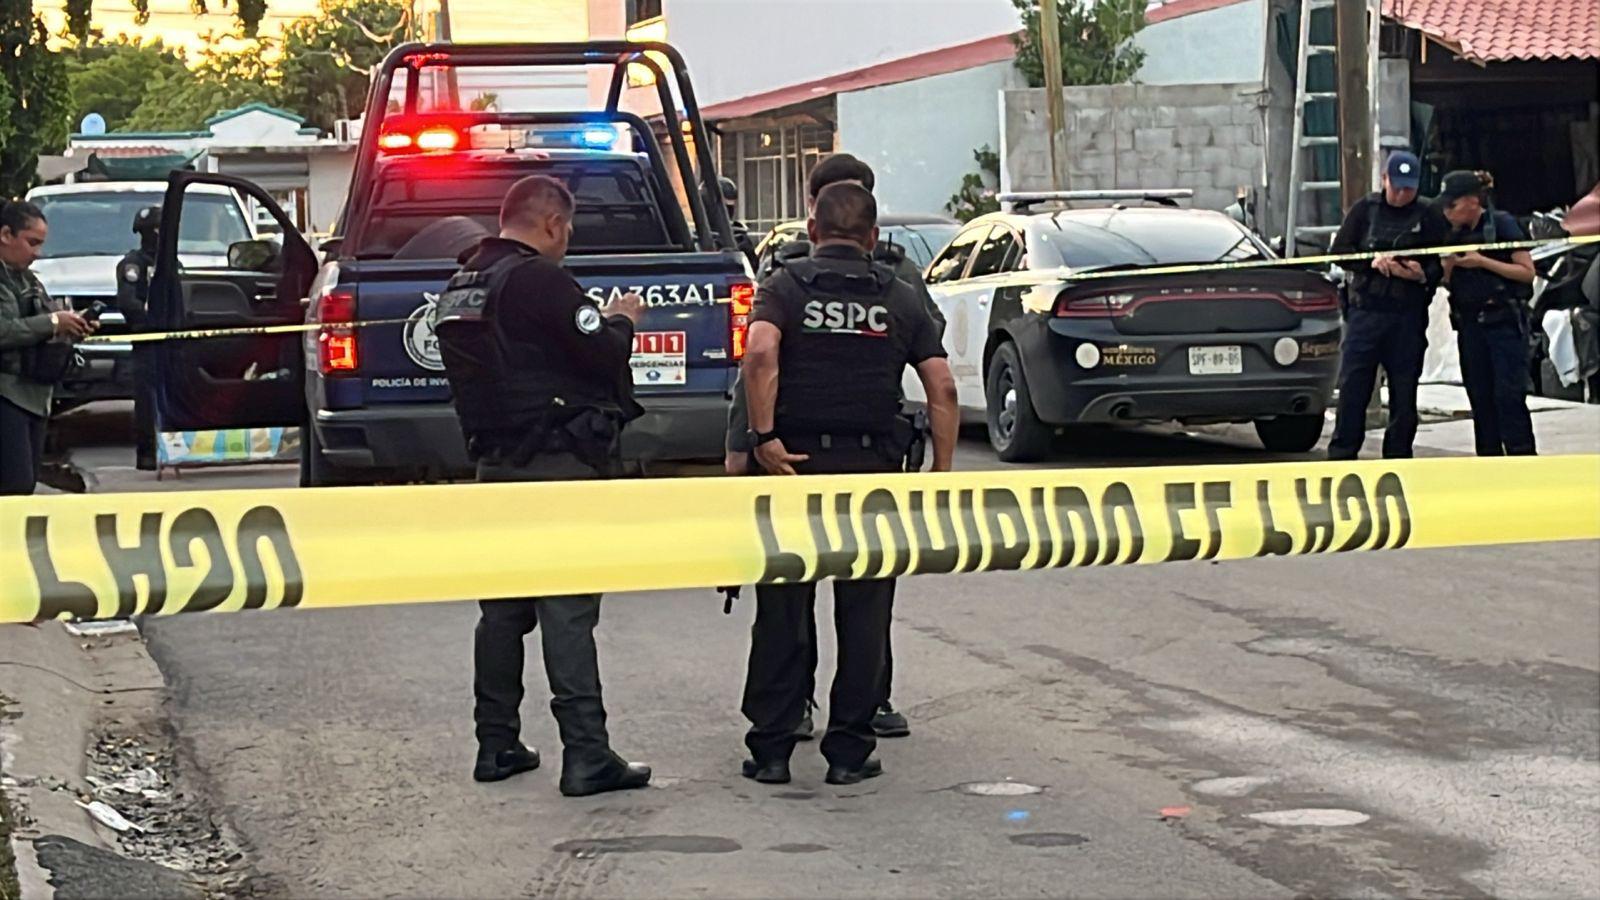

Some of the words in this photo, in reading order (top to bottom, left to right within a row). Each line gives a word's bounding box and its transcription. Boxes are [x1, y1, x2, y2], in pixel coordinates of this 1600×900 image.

[803, 300, 888, 332] SSPC
[1103, 353, 1156, 365] MÉXICO
[372, 377, 411, 387] POLICÍA
[413, 378, 427, 387] DE
